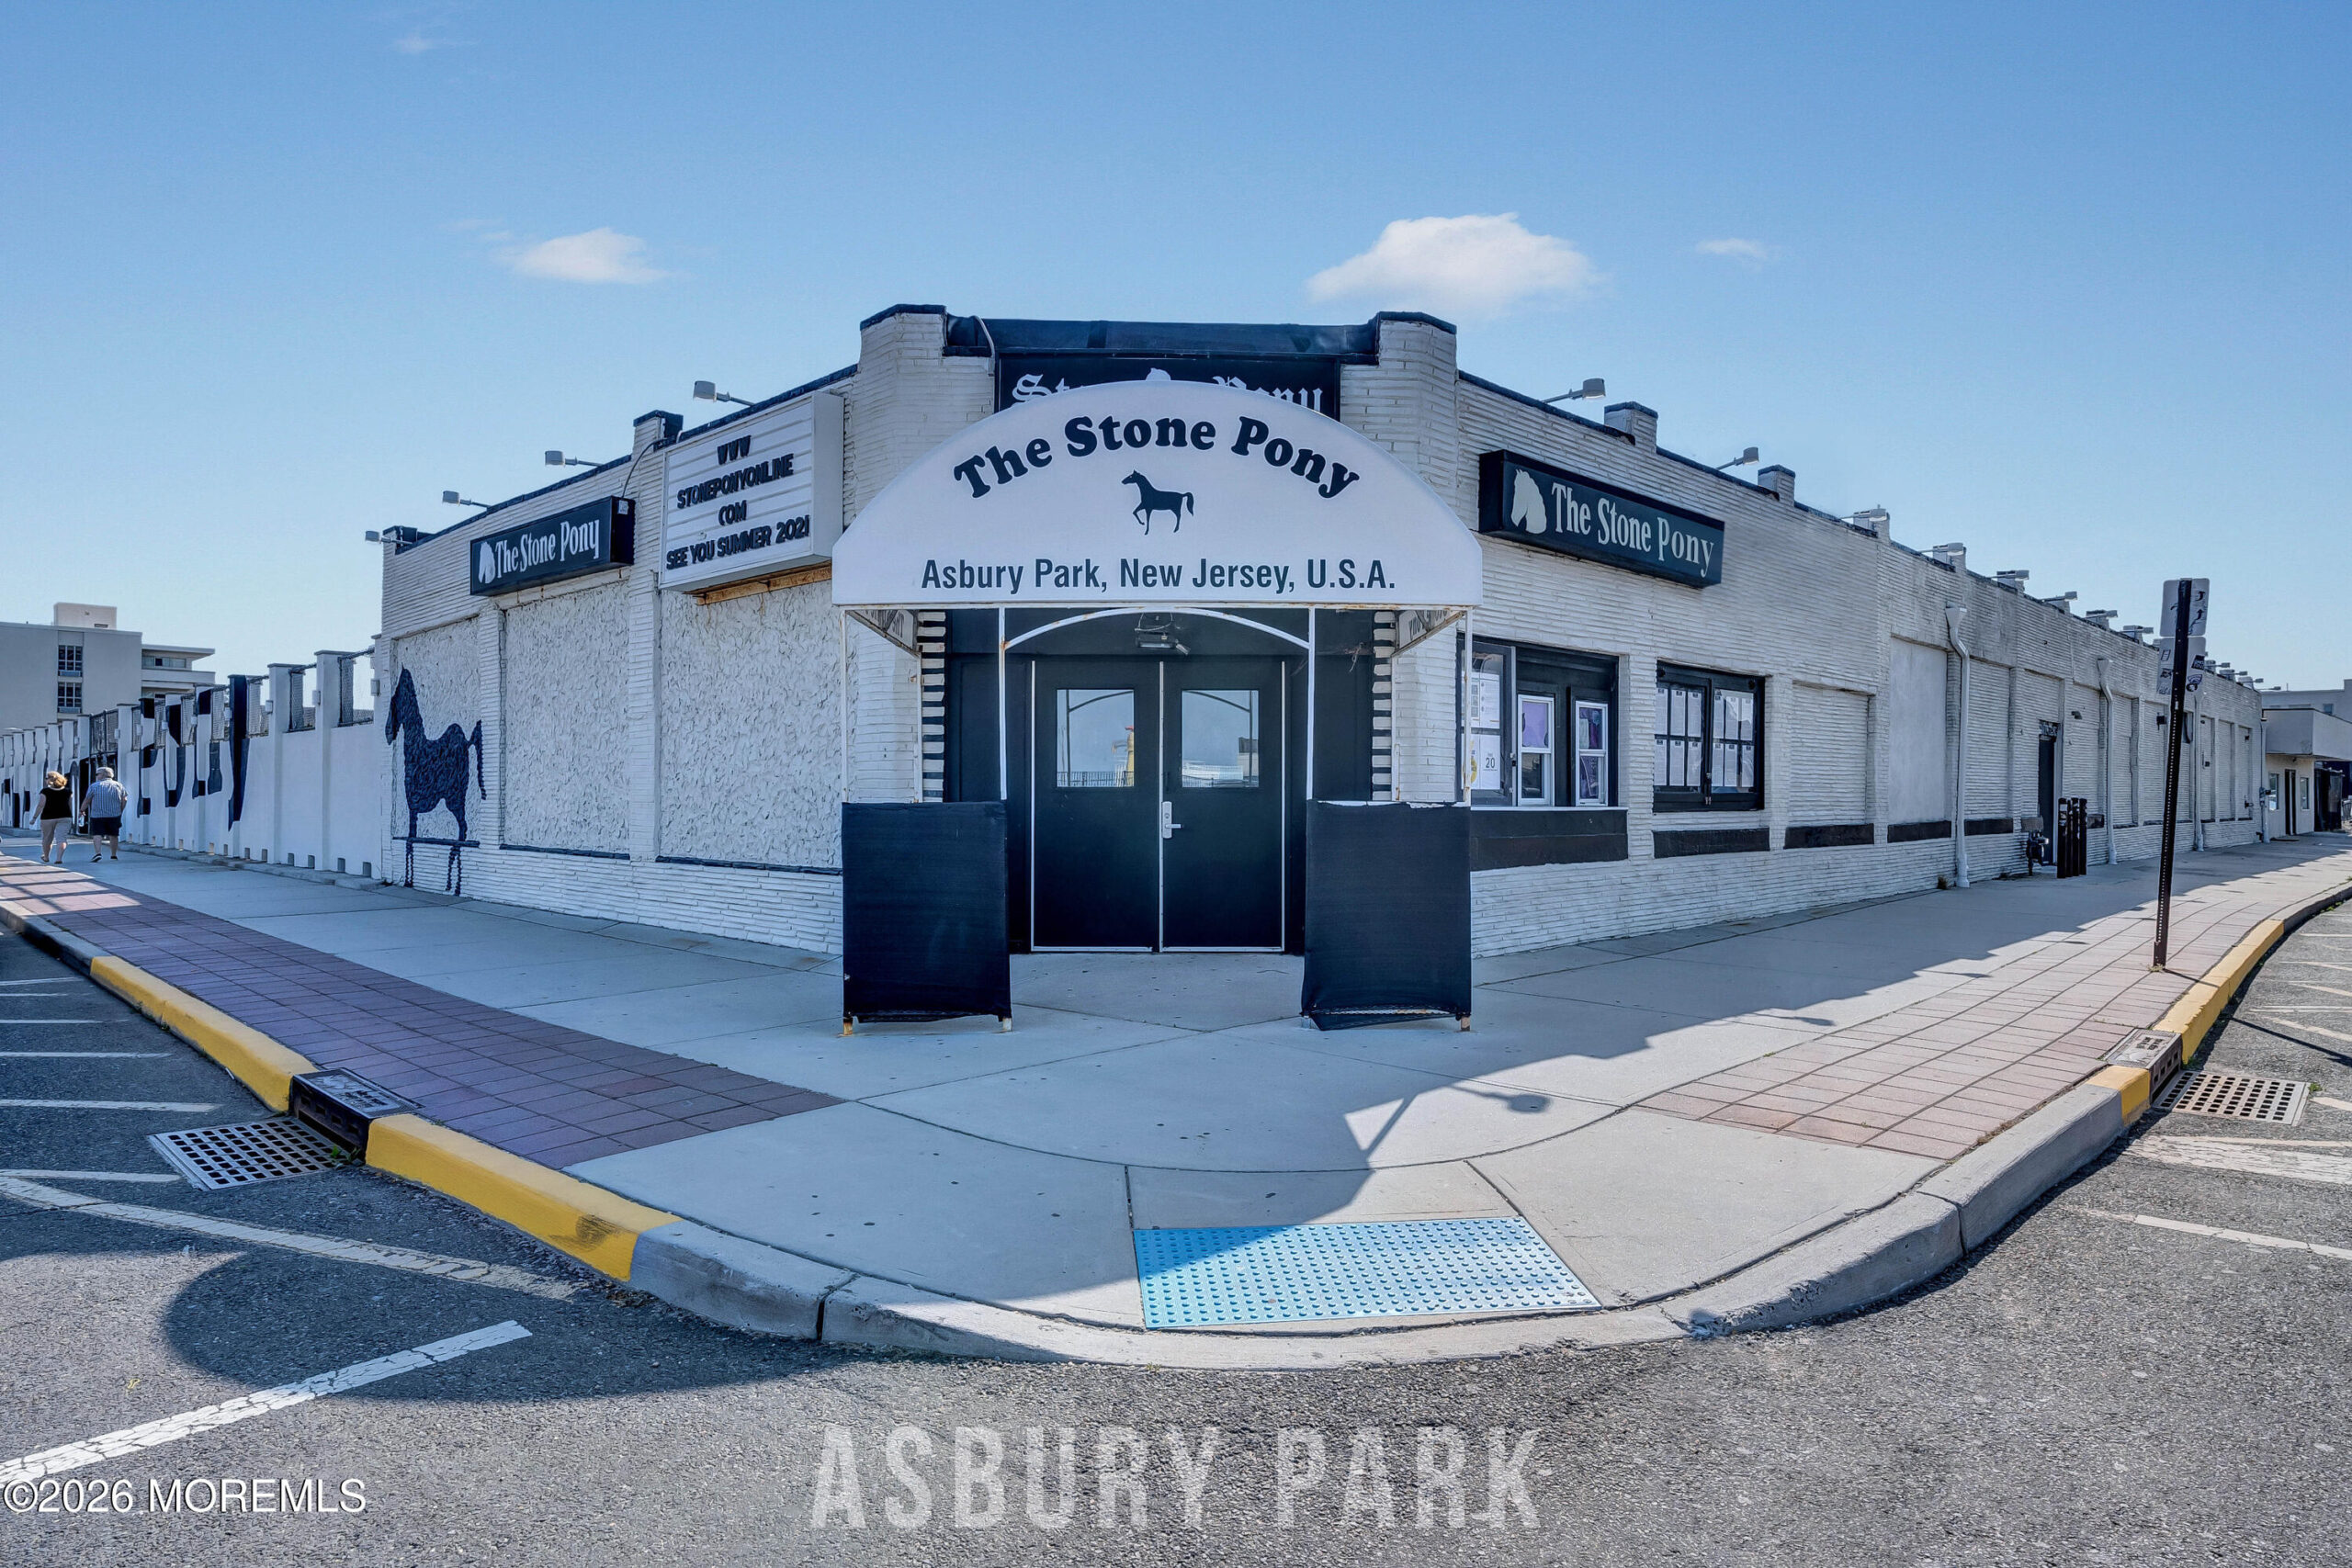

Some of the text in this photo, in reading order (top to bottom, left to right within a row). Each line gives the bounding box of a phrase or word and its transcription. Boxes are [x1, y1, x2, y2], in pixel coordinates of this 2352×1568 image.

[677, 453, 794, 509] STONEPONYONLINE
[954, 415, 1360, 499] The Stone Pony
[718, 500, 747, 525] COM
[1552, 482, 1714, 579] The Stone Pony
[495, 519, 600, 579] The Stone Pony
[666, 514, 809, 570] SEE YOU SUMMER 2021
[922, 558, 1396, 595] Asbury Park, New Jersey, U.S.A.
